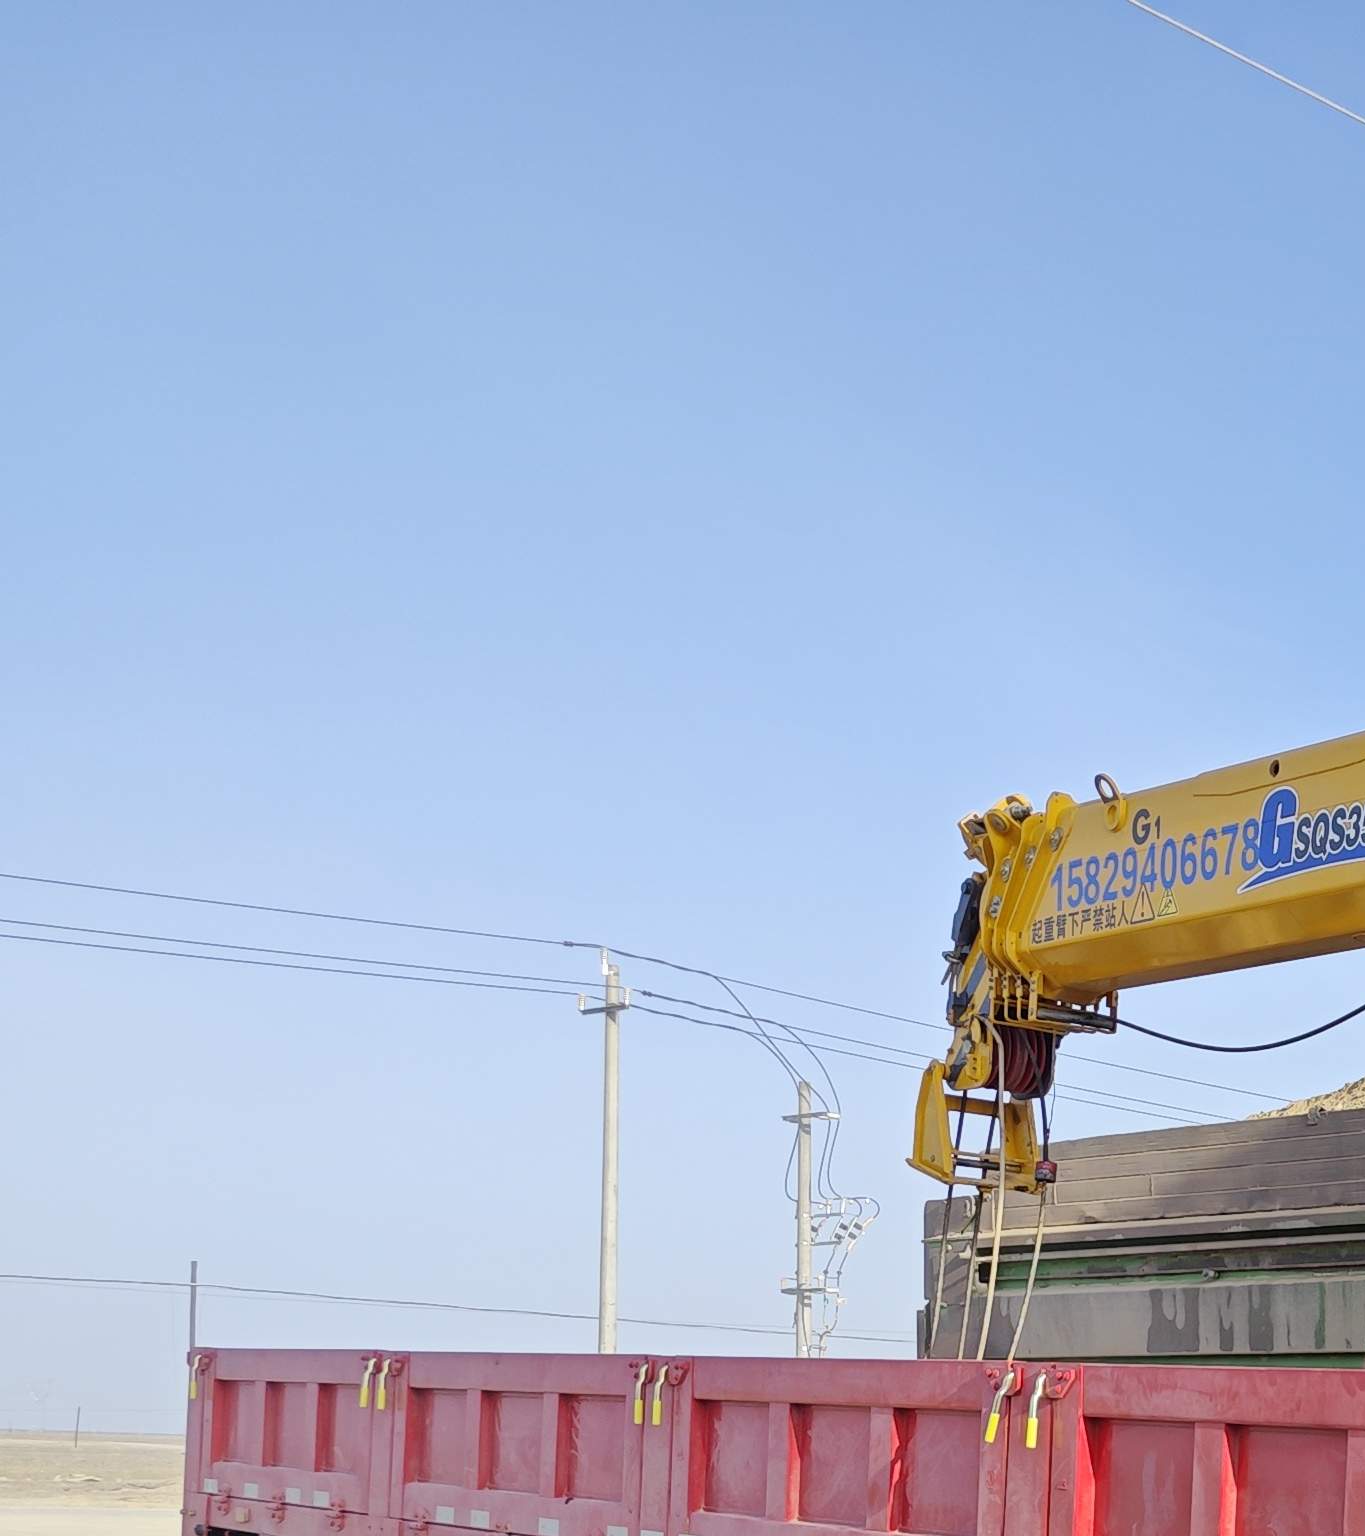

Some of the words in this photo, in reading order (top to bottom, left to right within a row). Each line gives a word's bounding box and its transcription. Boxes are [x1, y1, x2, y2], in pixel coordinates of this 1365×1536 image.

[1051, 818, 1259, 912] 15829406678
[1031, 900, 1129, 944] 起重臂下严禁站人
